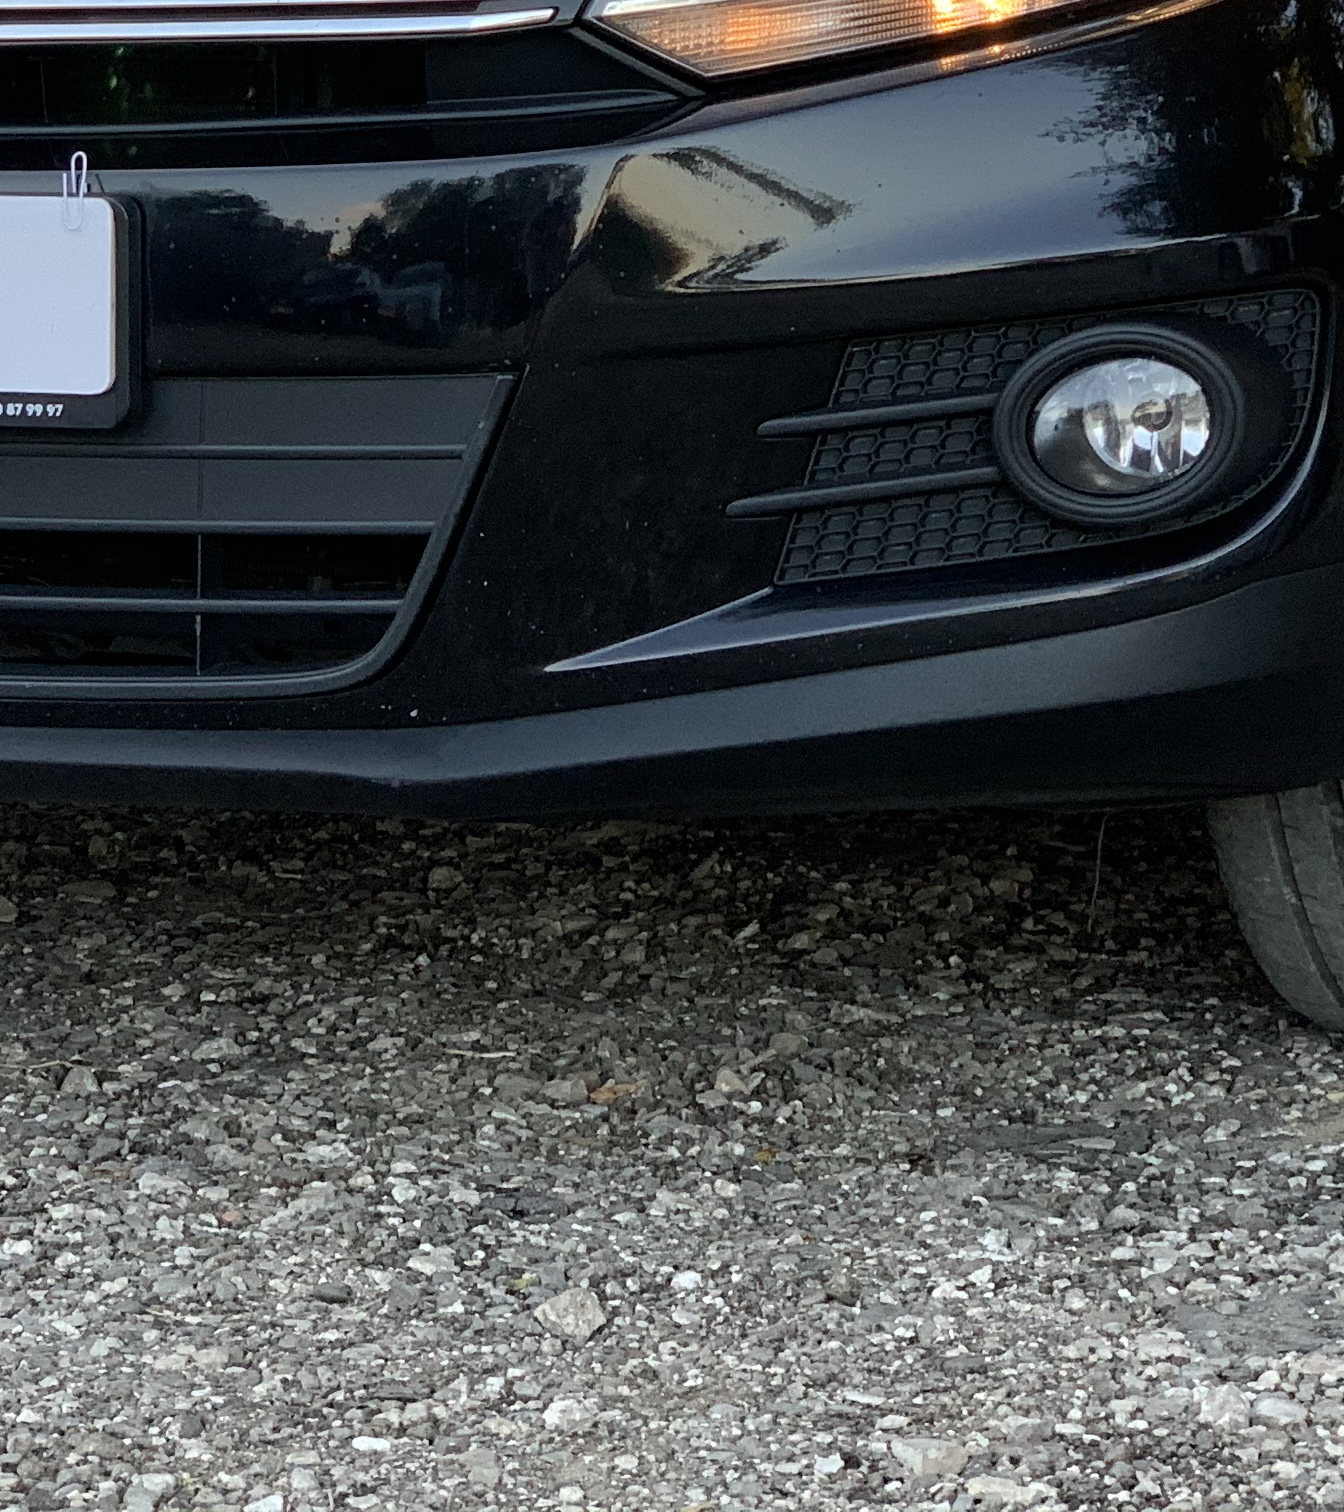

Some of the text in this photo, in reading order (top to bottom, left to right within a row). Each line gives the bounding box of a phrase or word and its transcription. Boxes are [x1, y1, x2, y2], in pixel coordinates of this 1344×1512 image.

[6, 402, 24, 416] 87
[25, 403, 44, 417] 99
[46, 403, 64, 417] 97
